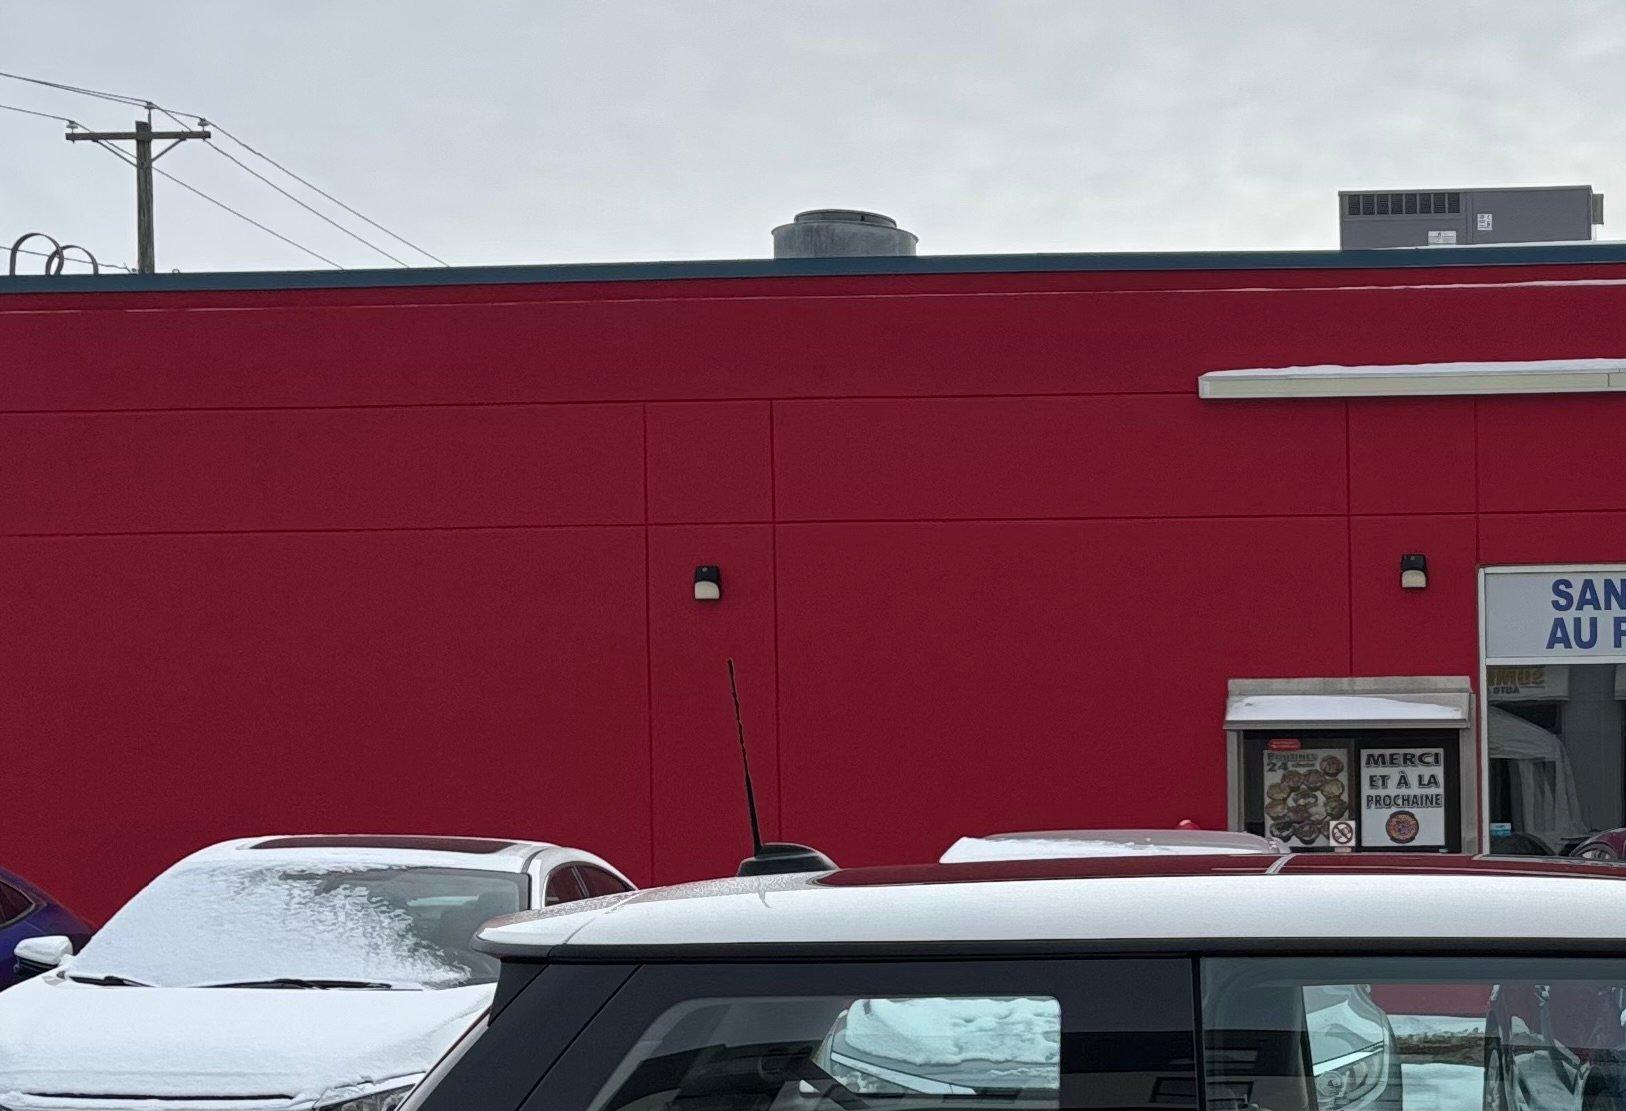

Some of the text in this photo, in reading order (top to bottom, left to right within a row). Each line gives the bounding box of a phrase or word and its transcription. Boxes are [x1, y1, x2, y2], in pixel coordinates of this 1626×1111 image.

[1545, 616, 1598, 649] AU
[1365, 752, 1442, 768] MERCI
[1369, 770, 1440, 789] ET À LA
[1366, 794, 1443, 809] PROCHAINE
